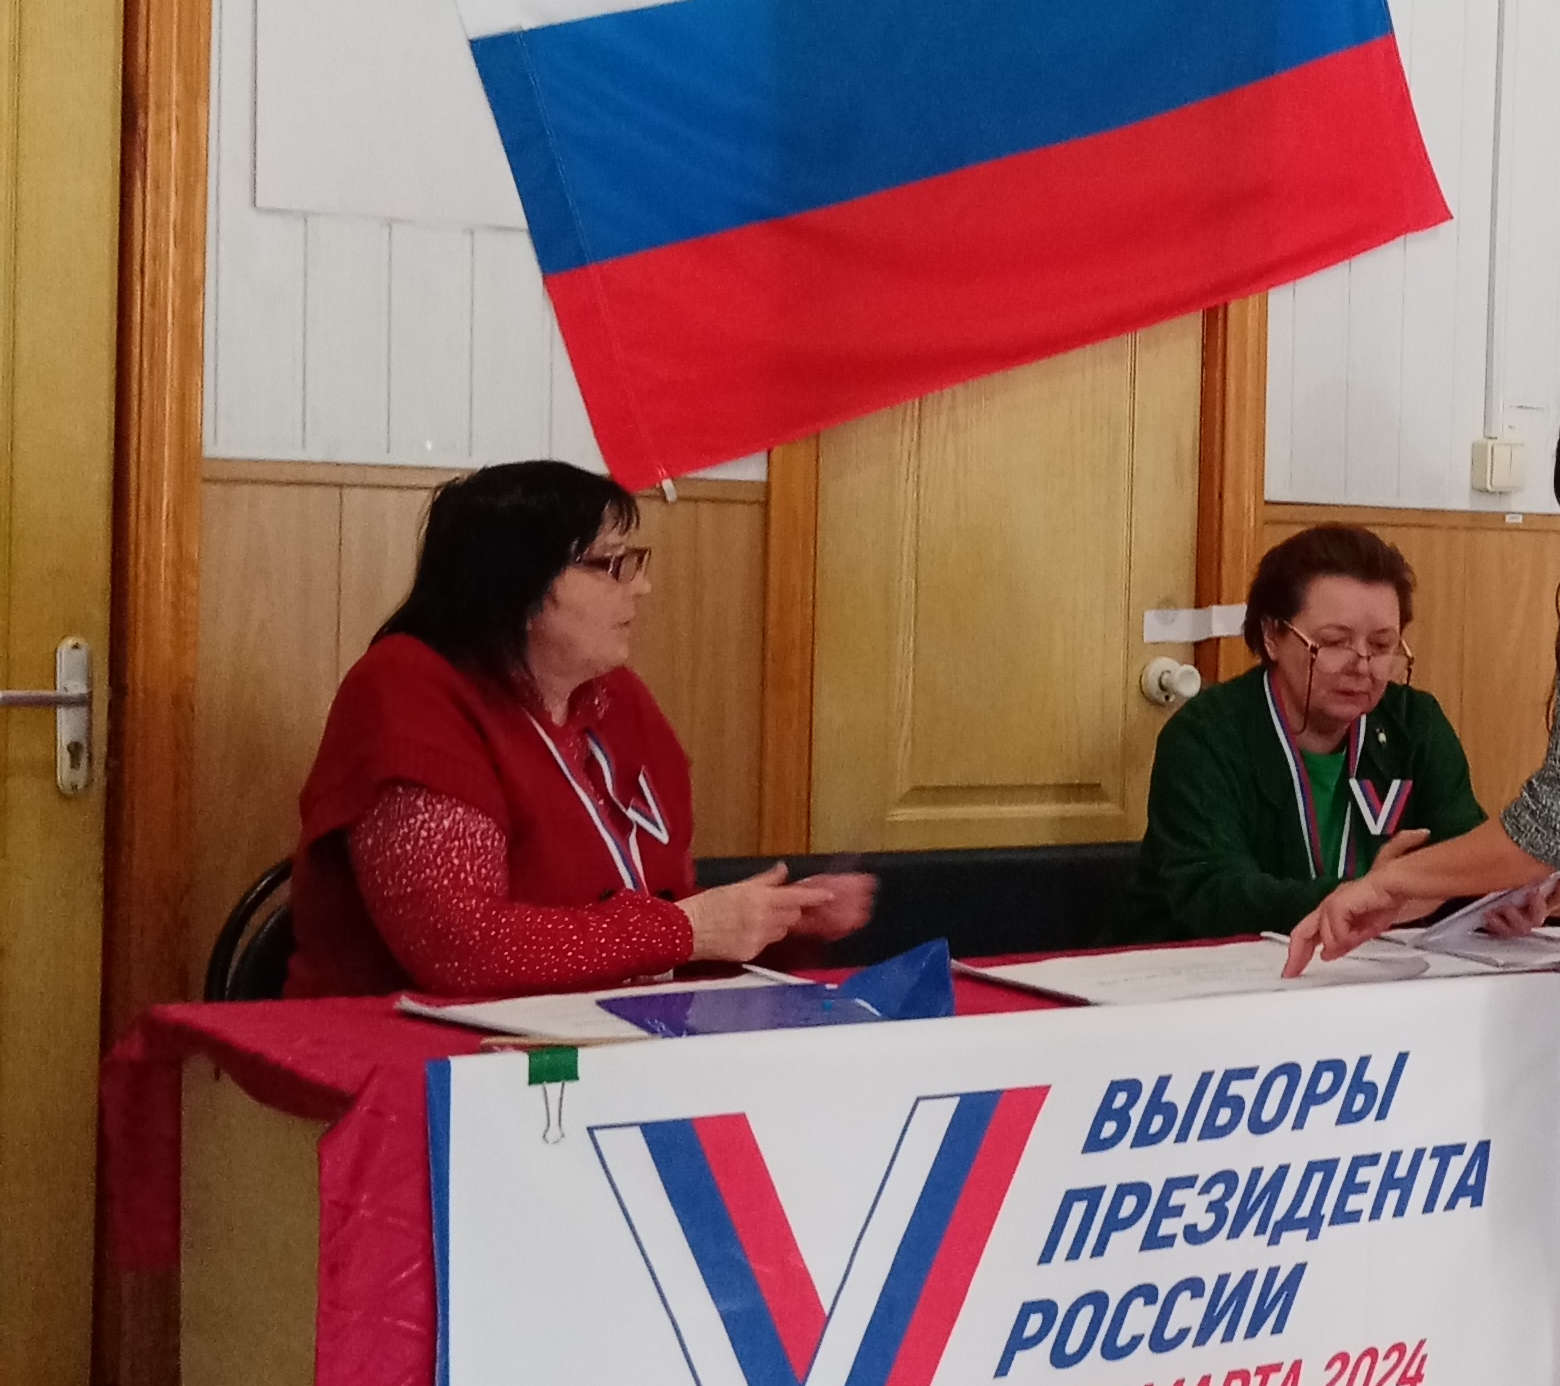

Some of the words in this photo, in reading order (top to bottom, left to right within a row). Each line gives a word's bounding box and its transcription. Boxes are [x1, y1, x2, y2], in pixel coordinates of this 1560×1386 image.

[1081, 1051, 1411, 1154] ВЫБОРЫ
[1036, 1139, 1492, 1266] ПРЕЗИДЕНТА
[993, 1261, 1308, 1380] РОССИИ
